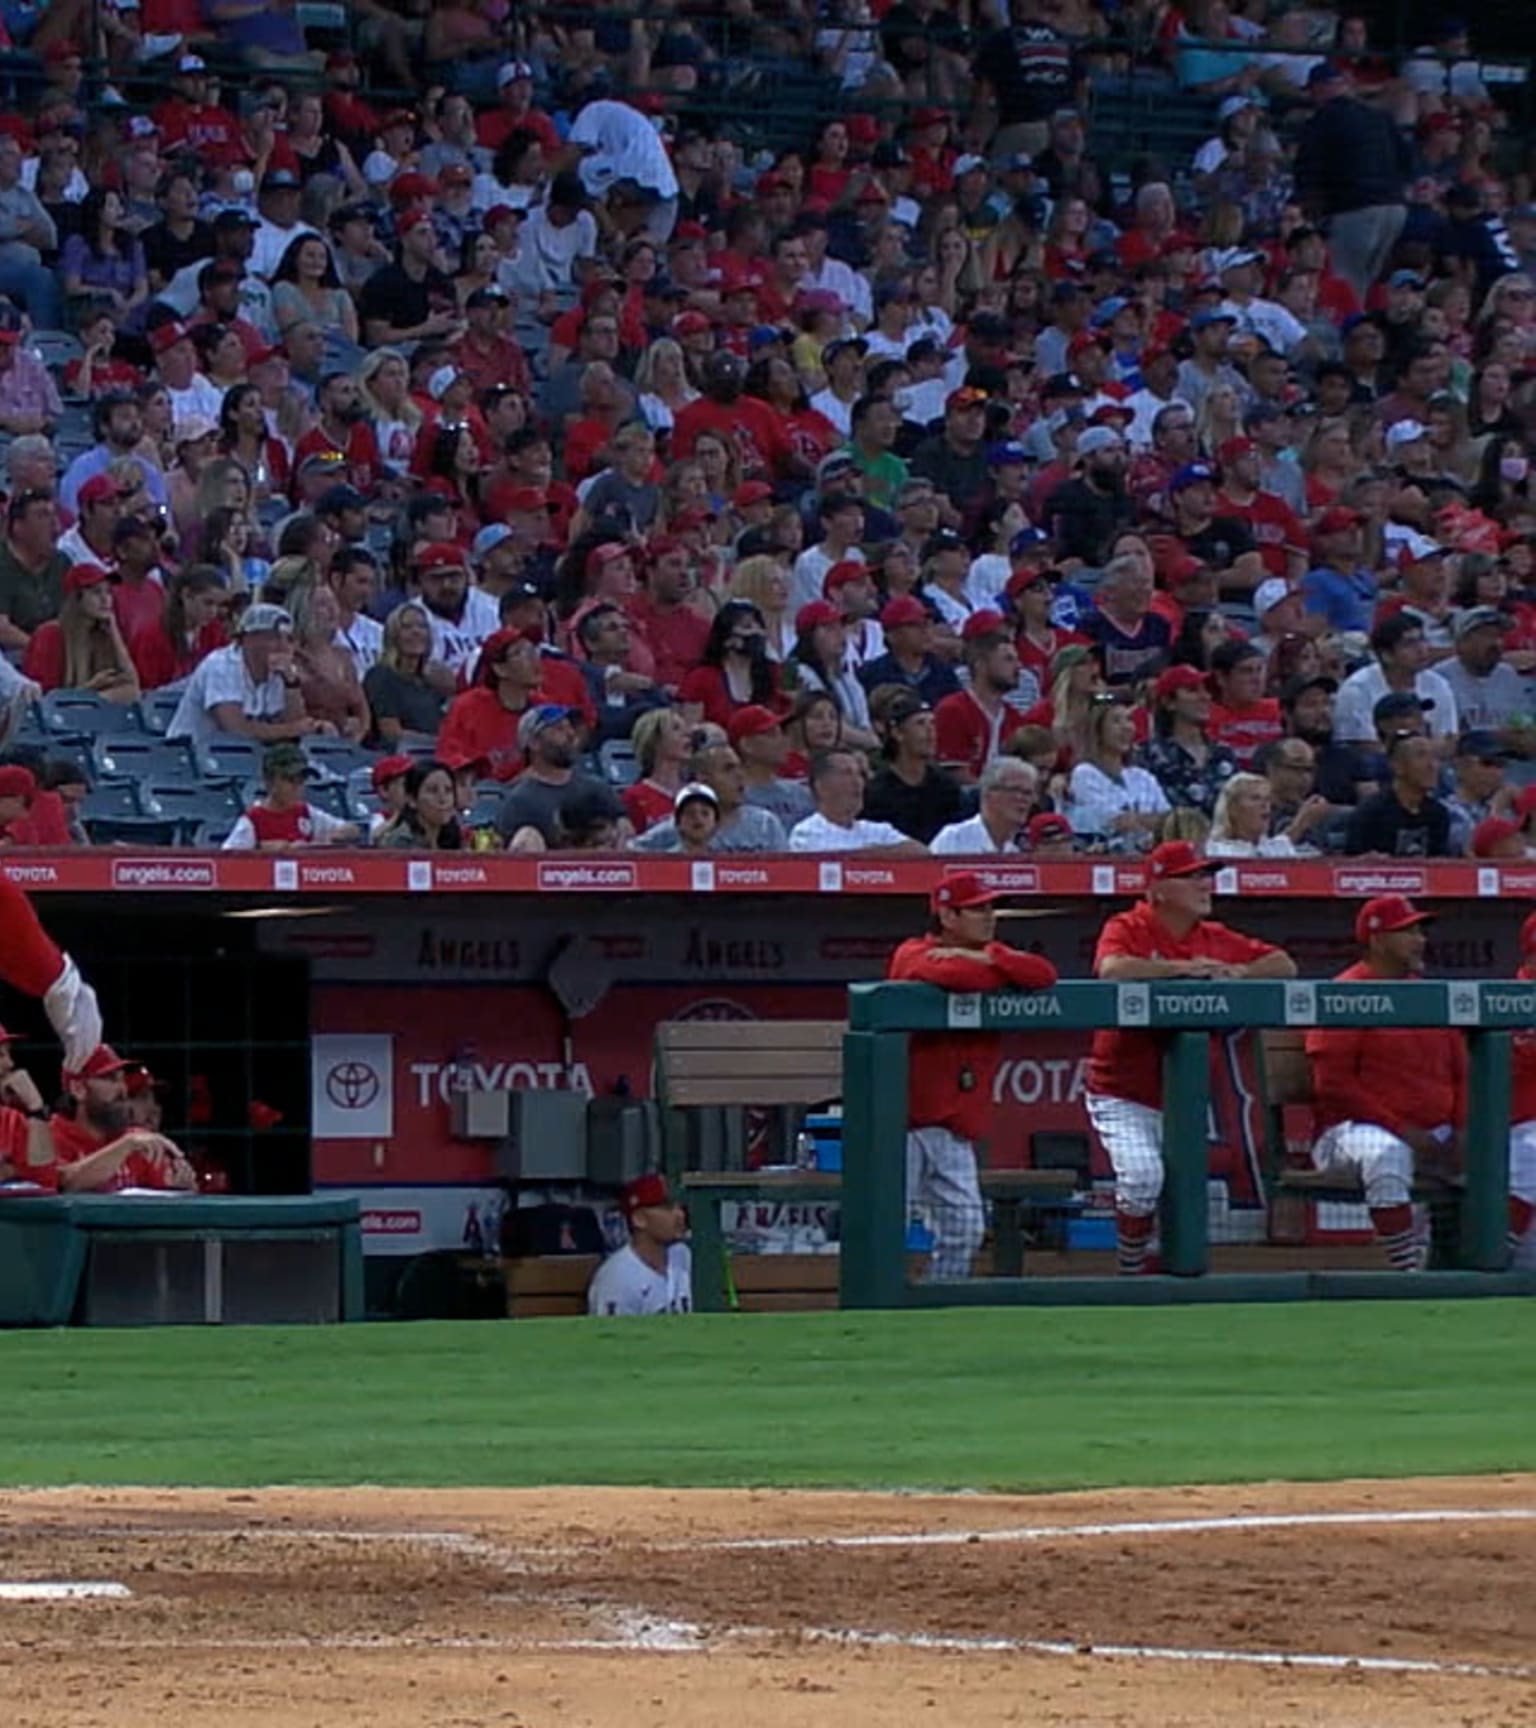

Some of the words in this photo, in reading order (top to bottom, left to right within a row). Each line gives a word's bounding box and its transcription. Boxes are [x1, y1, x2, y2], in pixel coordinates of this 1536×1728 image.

[5, 866, 58, 882] TOYOTA
[117, 864, 211, 884] angels.com
[302, 868, 354, 883] TOYOTA
[436, 868, 487, 883] TOYOTA
[543, 867, 632, 886] angels.com
[719, 870, 769, 884] TOYOTA
[845, 870, 895, 885] TOYOTA
[1241, 872, 1289, 887] TOYOTA
[1340, 874, 1422, 891] angels.com
[988, 996, 1062, 1017] TOYOTA
[1154, 995, 1230, 1015] TOYOTA
[1322, 995, 1395, 1014] TOYOTA
